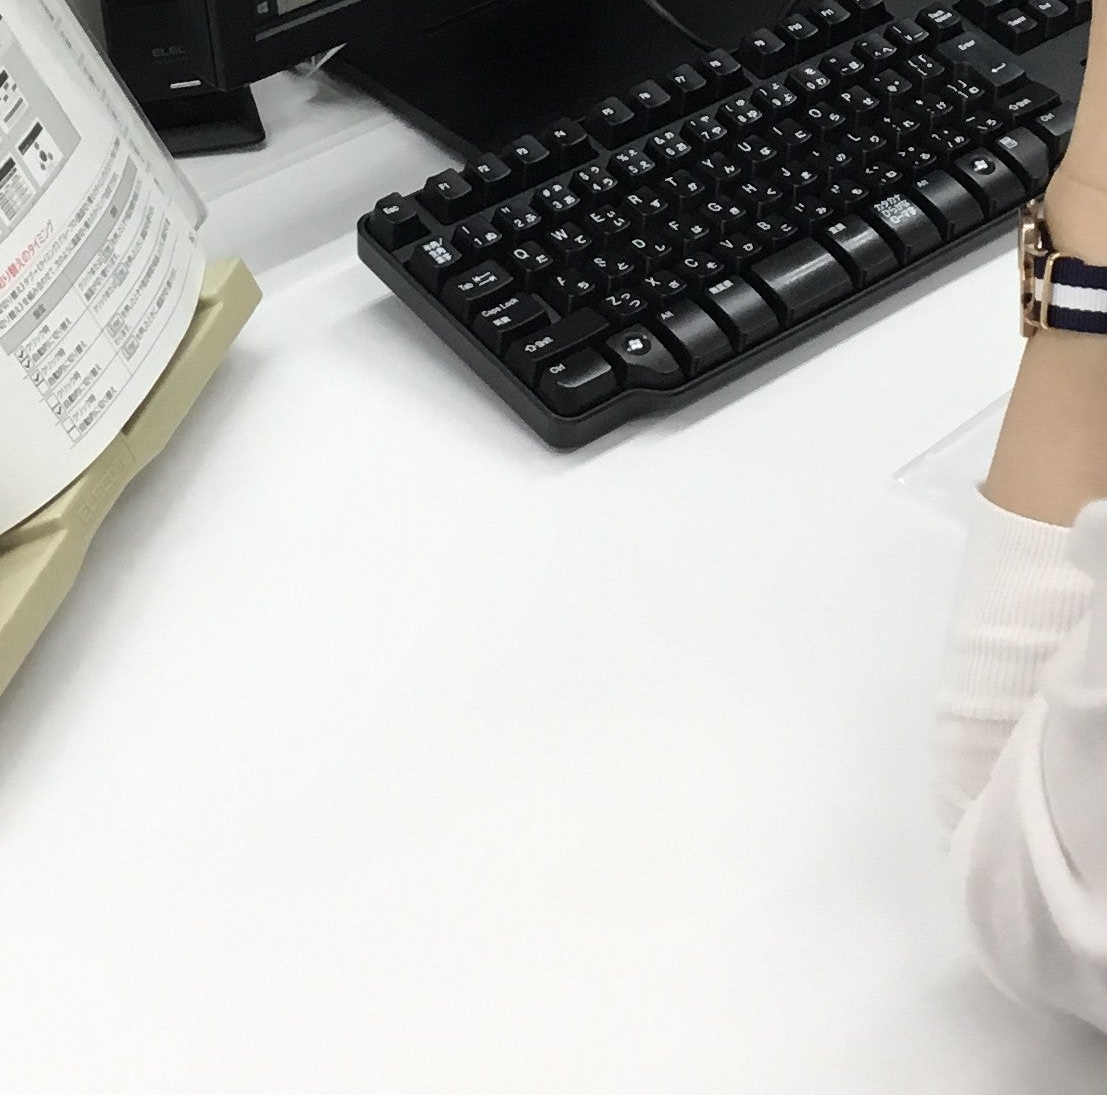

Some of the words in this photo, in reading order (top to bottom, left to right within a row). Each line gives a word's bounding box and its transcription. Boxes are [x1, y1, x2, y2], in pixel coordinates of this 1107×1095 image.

[742, 184, 757, 193] H
[628, 195, 642, 204] R
[590, 213, 605, 222] E
[551, 229, 568, 240] W
[514, 249, 529, 259] Q
[645, 277, 660, 286] X
[606, 296, 621, 305] Z
